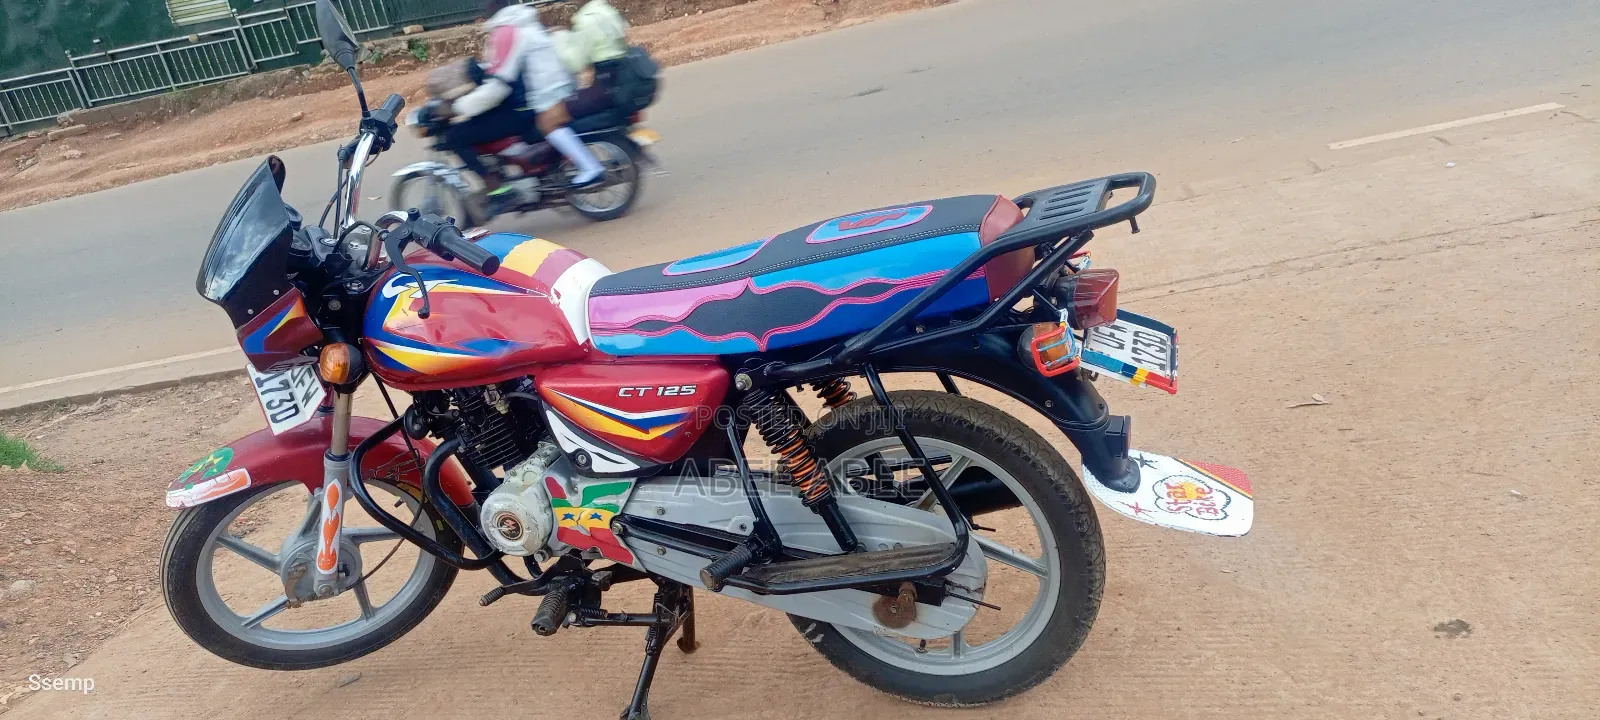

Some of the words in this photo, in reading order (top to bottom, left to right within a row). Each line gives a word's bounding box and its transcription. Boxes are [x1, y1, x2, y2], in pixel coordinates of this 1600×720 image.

[1131, 330, 1168, 371] 173D
[255, 370, 300, 424] 173D
[618, 386, 653, 397] CT
[656, 384, 697, 397] 125
[1163, 482, 1194, 512] Star
[1192, 486, 1220, 517] Bike
